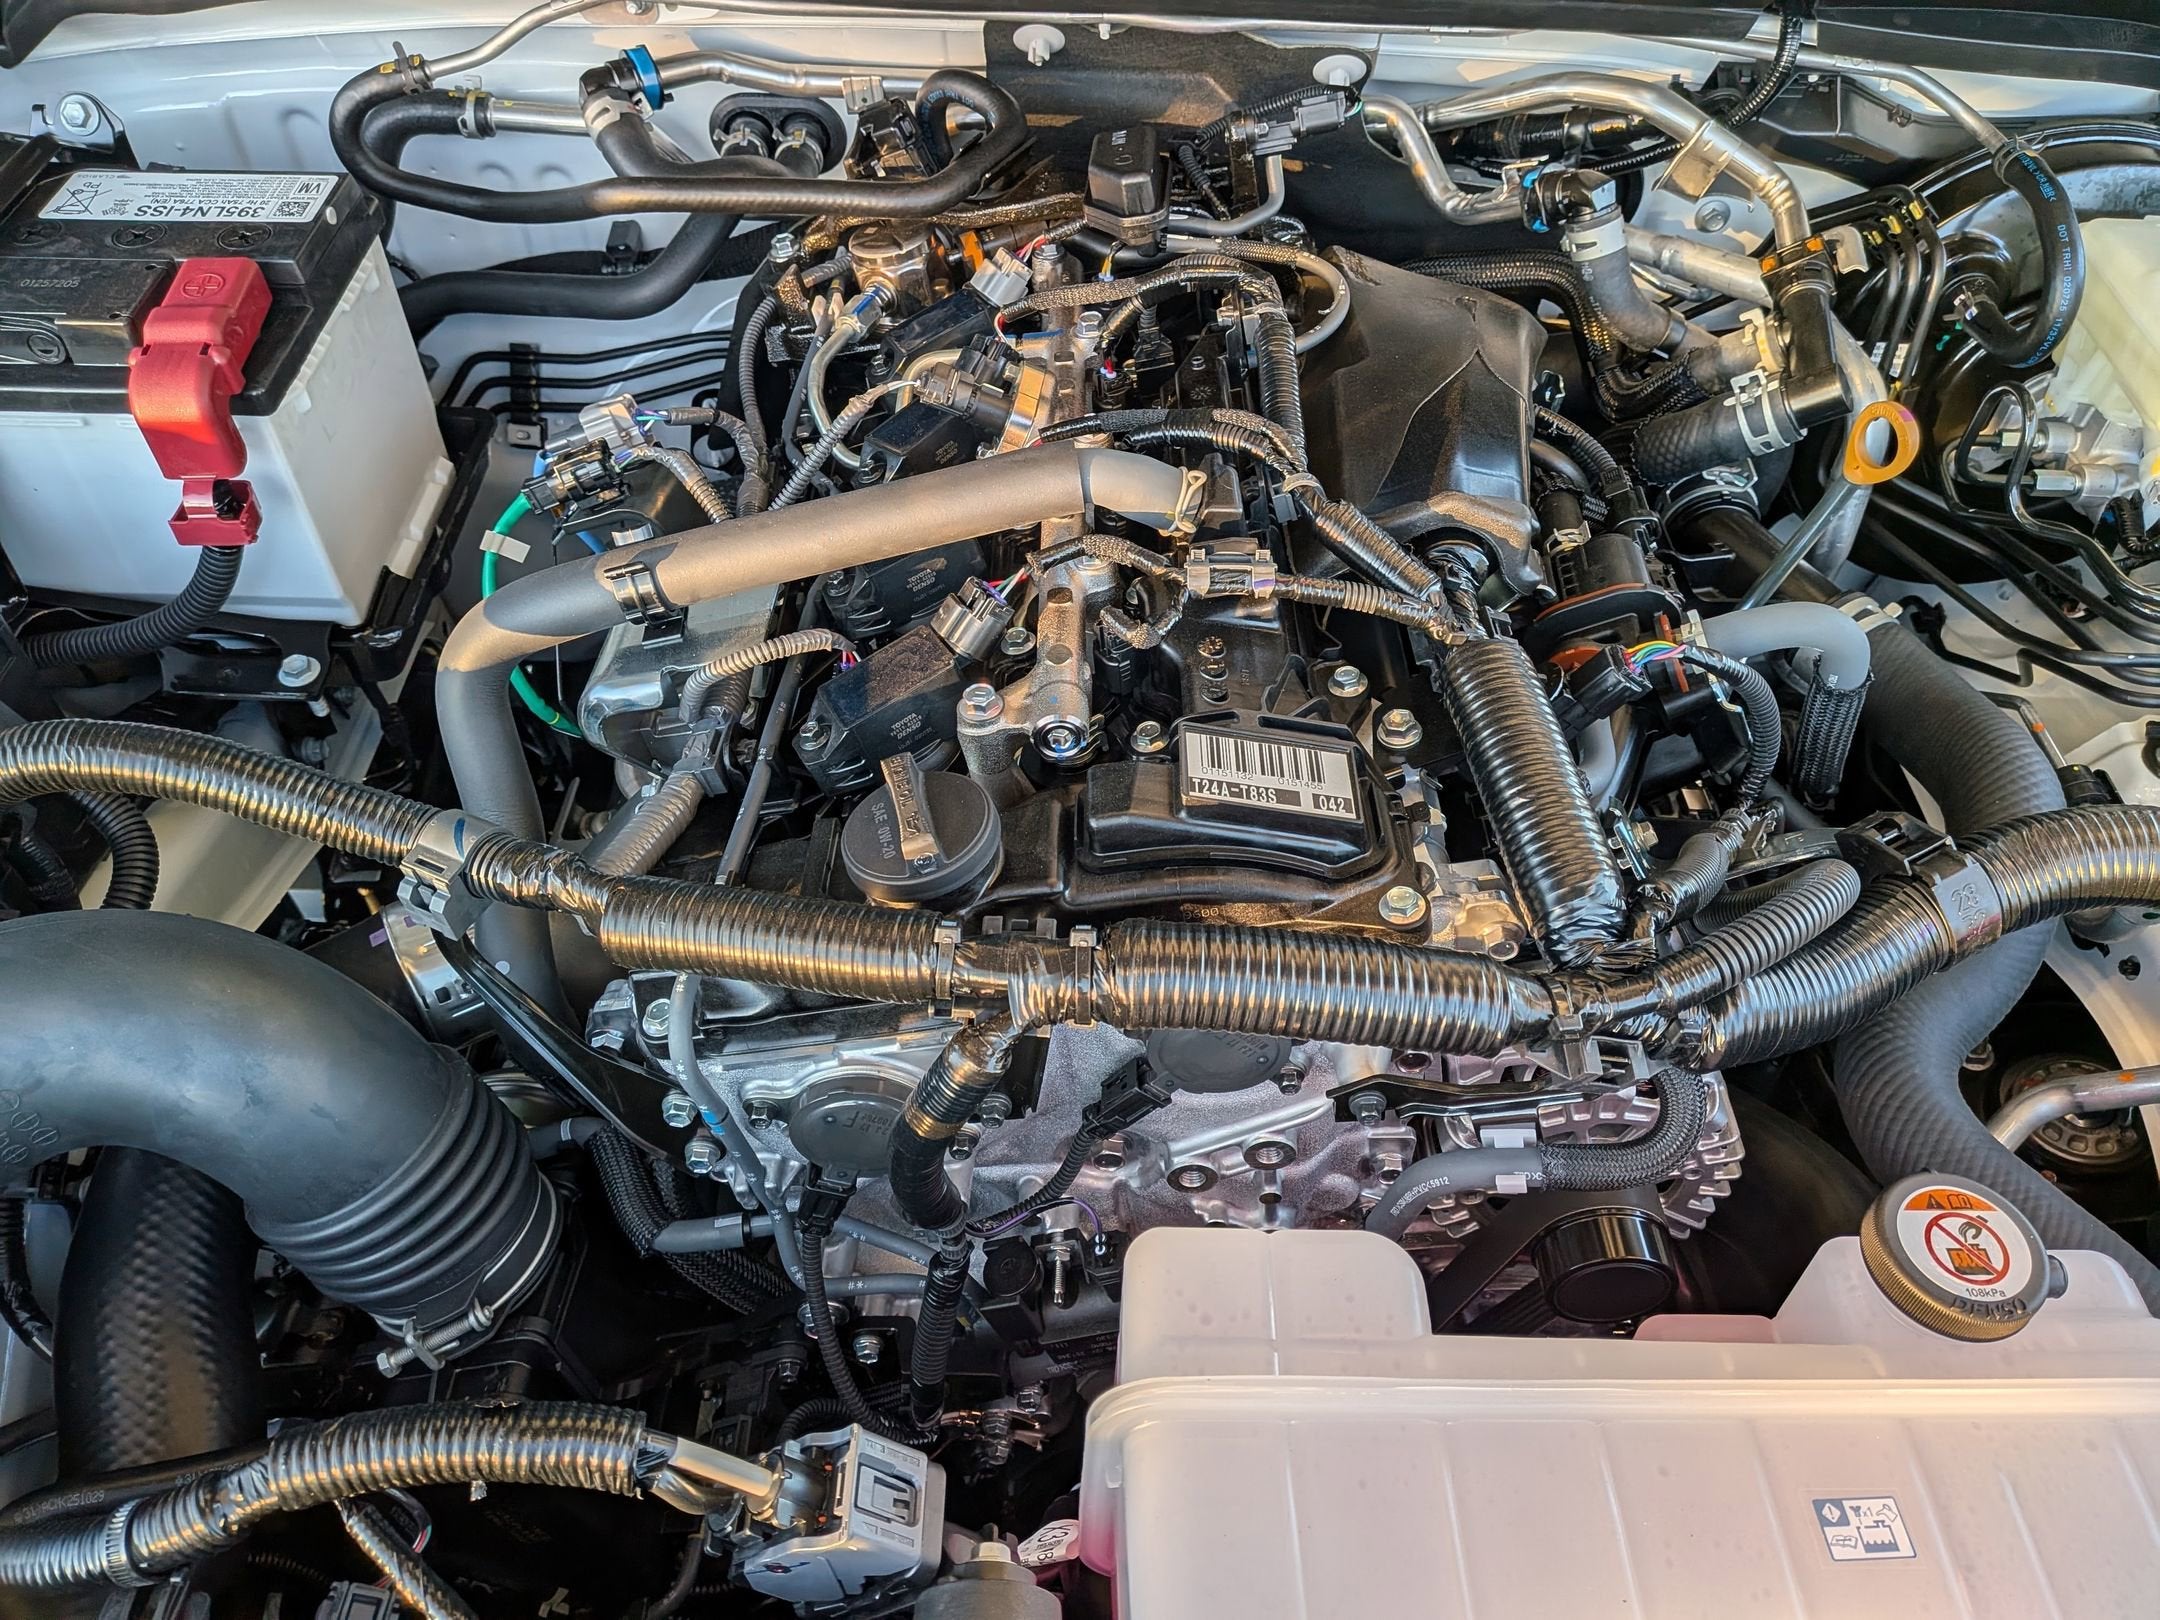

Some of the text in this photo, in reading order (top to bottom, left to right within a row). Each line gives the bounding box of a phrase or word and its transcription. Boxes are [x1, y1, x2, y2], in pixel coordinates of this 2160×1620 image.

[298, 182, 321, 194] VM
[134, 205, 266, 218] 395LN4-ISS
[2057, 224, 2069, 243] DOT
[907, 568, 932, 583] TOYOTA
[912, 576, 936, 592] DENSO
[891, 712, 917, 730] TOYOTA
[897, 721, 921, 740] DENSO
[1201, 766, 1324, 791] 01151132 0151455
[1192, 777, 1346, 813] T24A-T83S 042
[871, 803, 897, 860] SAE 0W-20
[1965, 1288, 2007, 1298] 108kPa
[1951, 1298, 2027, 1320] DENSO
